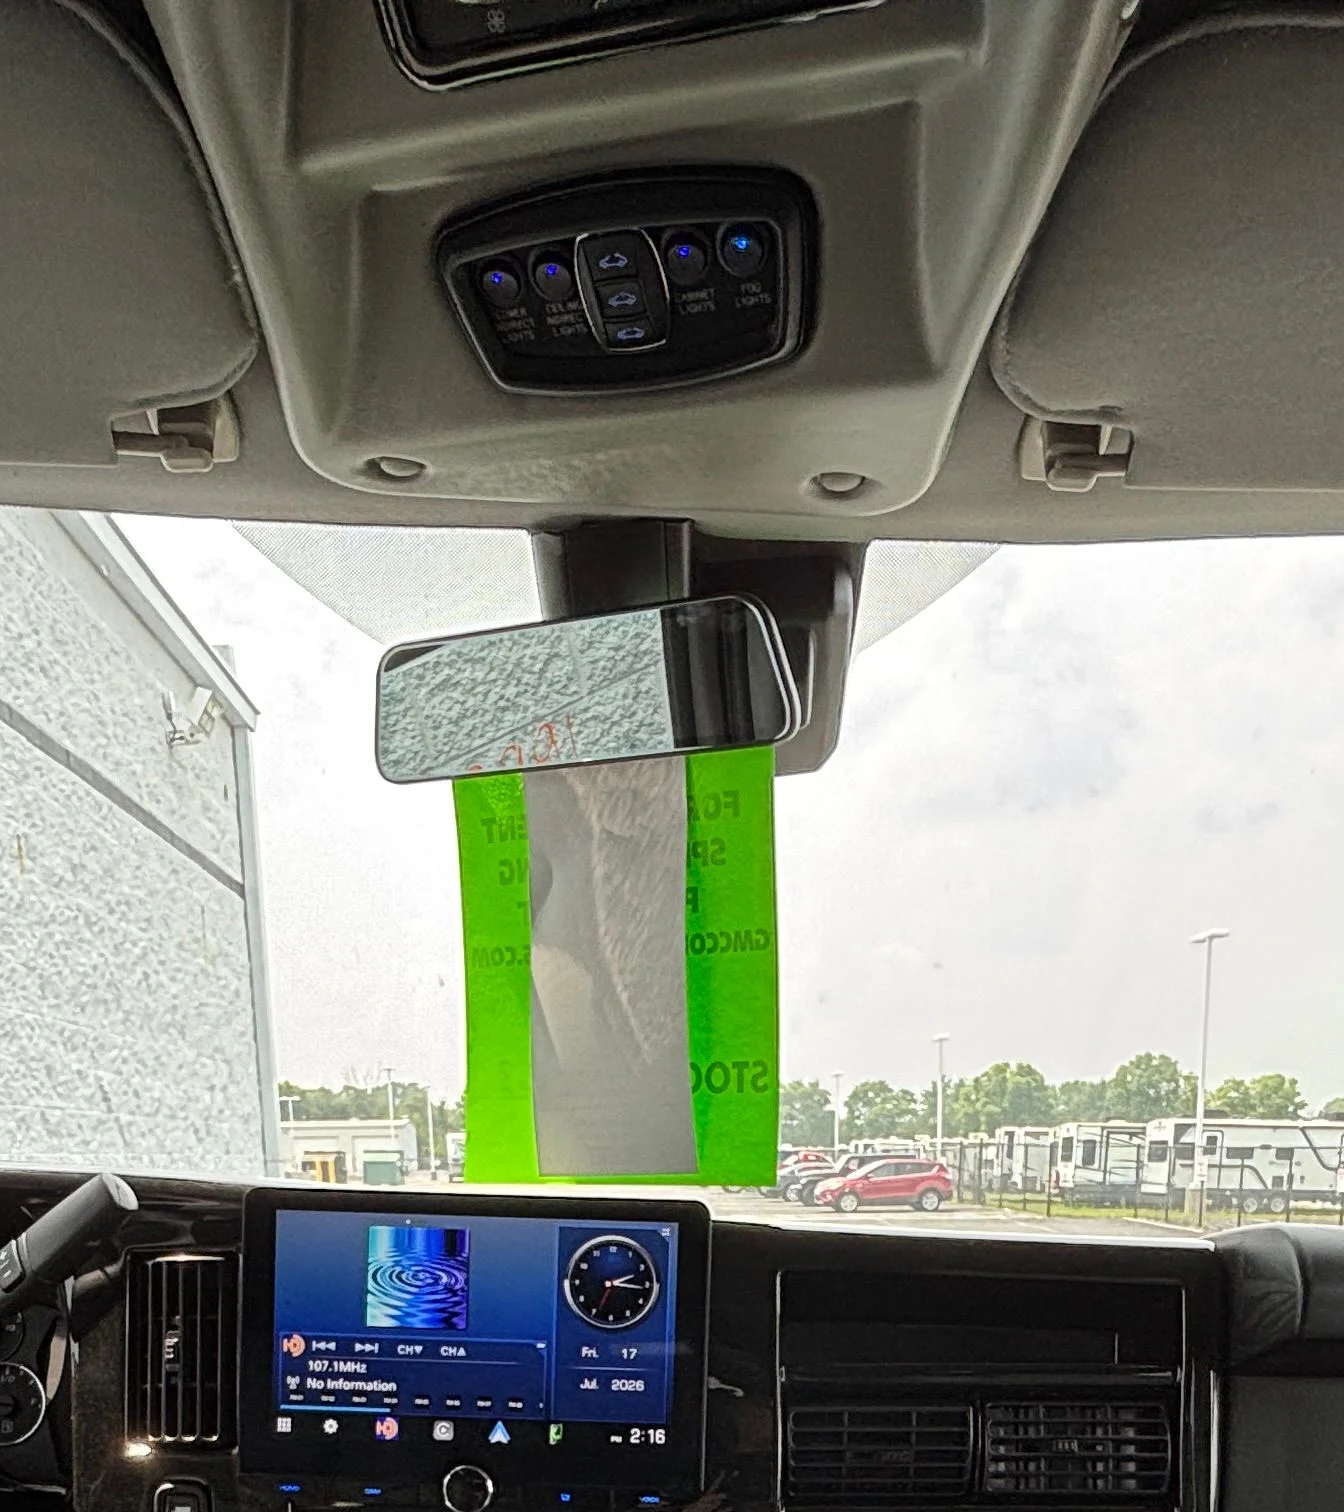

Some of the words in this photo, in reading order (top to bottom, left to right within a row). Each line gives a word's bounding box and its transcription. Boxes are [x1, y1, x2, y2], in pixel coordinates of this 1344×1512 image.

[581, 1346, 599, 1359] Fri.
[621, 1348, 638, 1360] 17
[308, 1360, 367, 1374] 107.1MHz
[307, 1377, 325, 1390] No
[326, 1378, 397, 1393] Information
[579, 1377, 599, 1390] Jul.
[611, 1379, 645, 1392] 2026
[629, 1427, 666, 1444] 2:16
